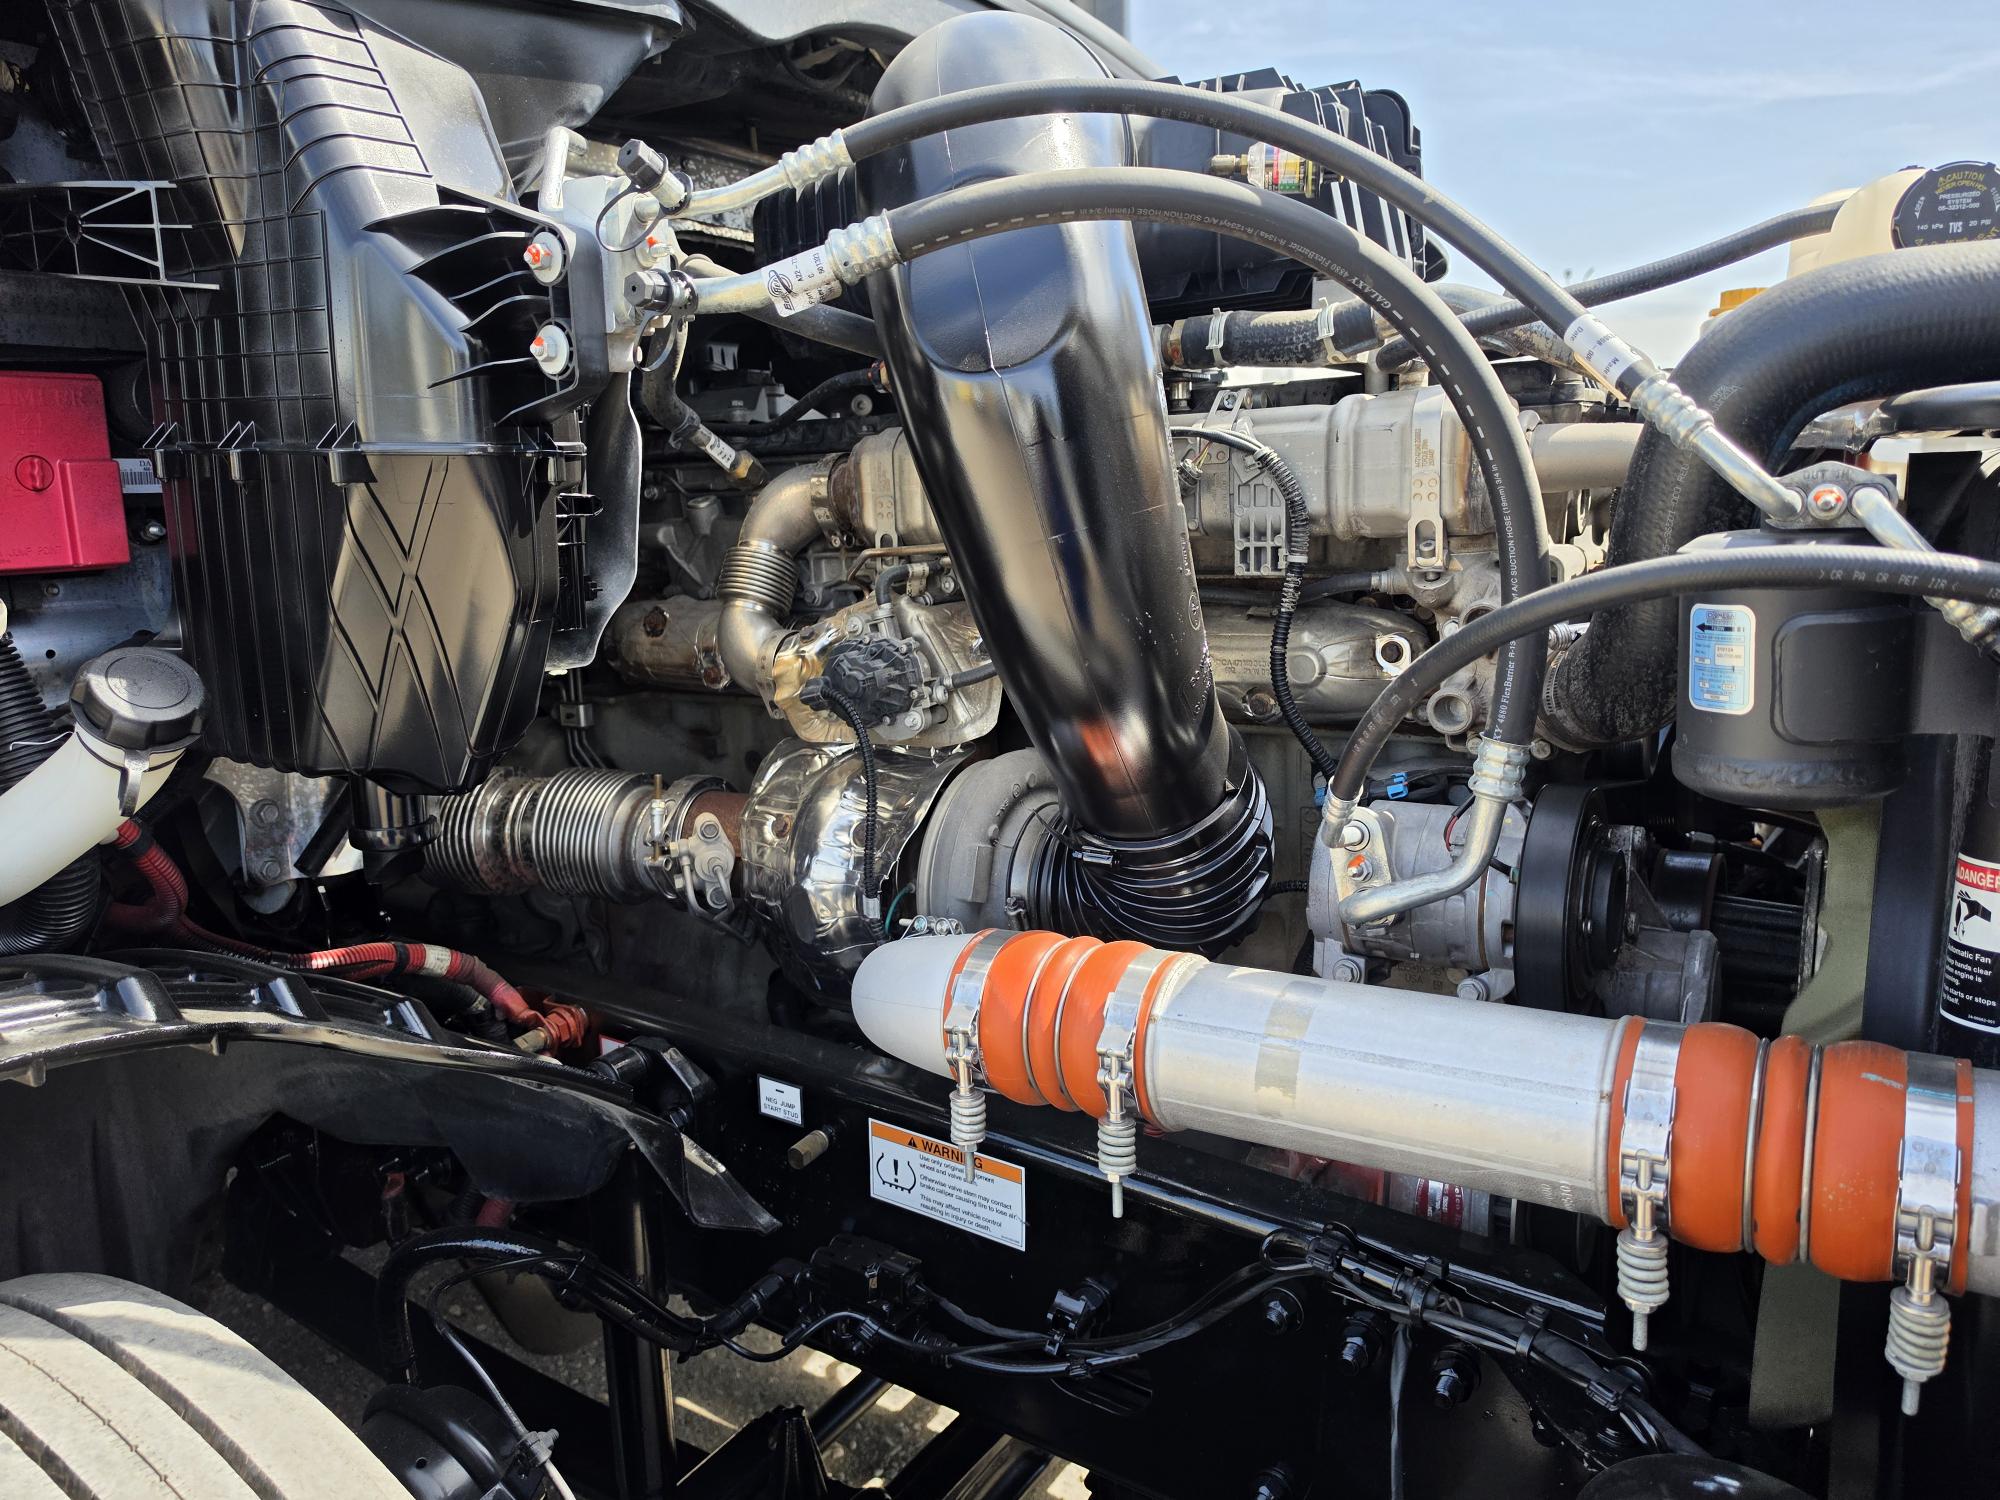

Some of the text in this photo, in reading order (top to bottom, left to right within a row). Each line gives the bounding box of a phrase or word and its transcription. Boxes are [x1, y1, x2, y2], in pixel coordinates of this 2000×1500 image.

[1946, 171, 1984, 181] CAUTION
[1137, 208, 1161, 216] HOSE
[1163, 210, 1202, 222] SUCTION
[1949, 222, 1963, 233] TVS
[1288, 243, 1330, 267] FlexBarrier
[1331, 263, 1350, 277] 4880
[1351, 275, 1392, 309] GALAXY
[1493, 472, 1502, 485] 3/4
[1504, 515, 1513, 538] HOSE
[1508, 541, 1517, 576] SUCTION
[1898, 574, 1919, 586] PET
[1501, 661, 1515, 703] FlexBarrier
[1975, 953, 1992, 964] Fan
[1955, 970, 1974, 981] engine
[1973, 967, 1992, 976] clear
[1974, 997, 1997, 1007] stops
[763, 1103, 781, 1113] START
[783, 1109, 799, 1119] STUD
[765, 1096, 795, 1110] NEG JUMP
[922, 1139, 983, 1169] WARNIG
[919, 1154, 930, 1163] Use
[930, 1157, 942, 1168] only
[944, 1160, 964, 1174] original
[920, 1163, 934, 1173] wheel
[935, 1168, 946, 1176] and
[947, 1171, 962, 1181] valve
[919, 1174, 1012, 1210] Otherwise valve stem may contact
[919, 1182, 935, 1193] brake
[935, 1187, 954, 1200] caliper
[955, 1194, 977, 1208] causing
[977, 1200, 988, 1209] tire
[995, 1206, 1008, 1217] lose
[920, 1194, 1002, 1228] This may affect vehicle control
[920, 1203, 944, 1218] resulting
[950, 1211, 967, 1225] injury
[974, 1219, 992, 1232] death.
